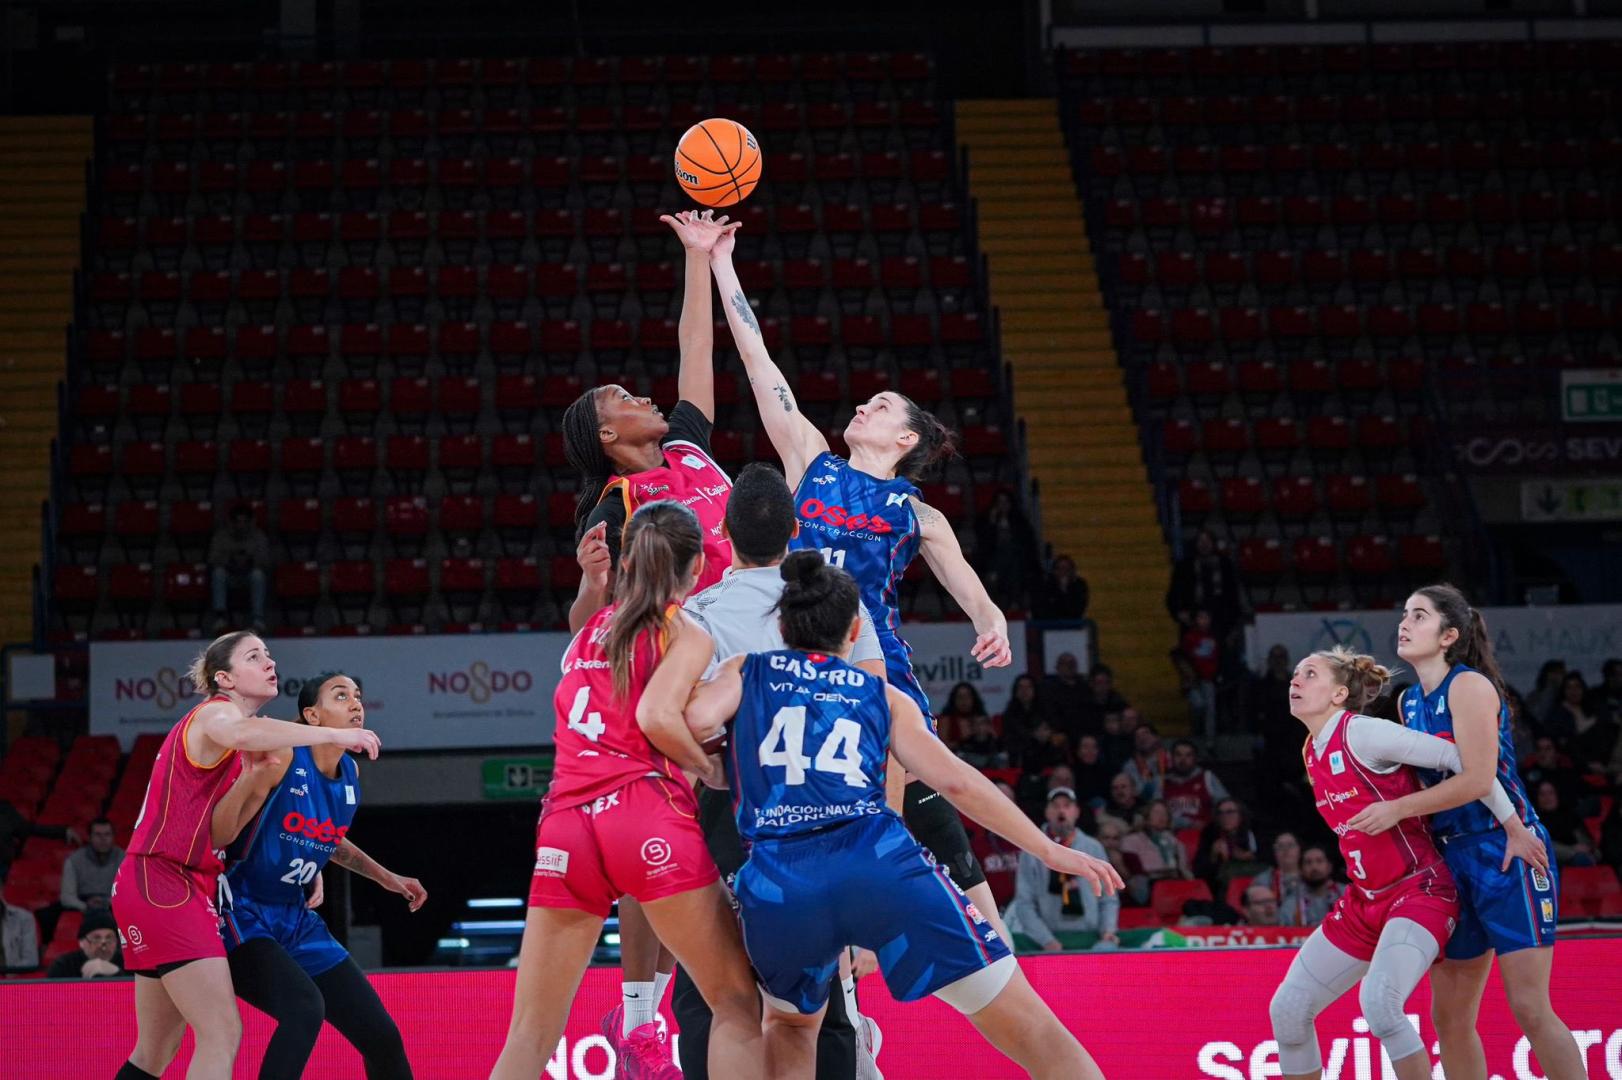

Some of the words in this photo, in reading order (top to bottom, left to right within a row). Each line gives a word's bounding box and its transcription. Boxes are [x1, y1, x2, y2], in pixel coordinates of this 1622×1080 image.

[912, 656, 982, 681] evilla
[567, 686, 606, 742] 4
[758, 705, 871, 788] 44
[280, 858, 318, 886] 20
[1348, 850, 1367, 880] 3
